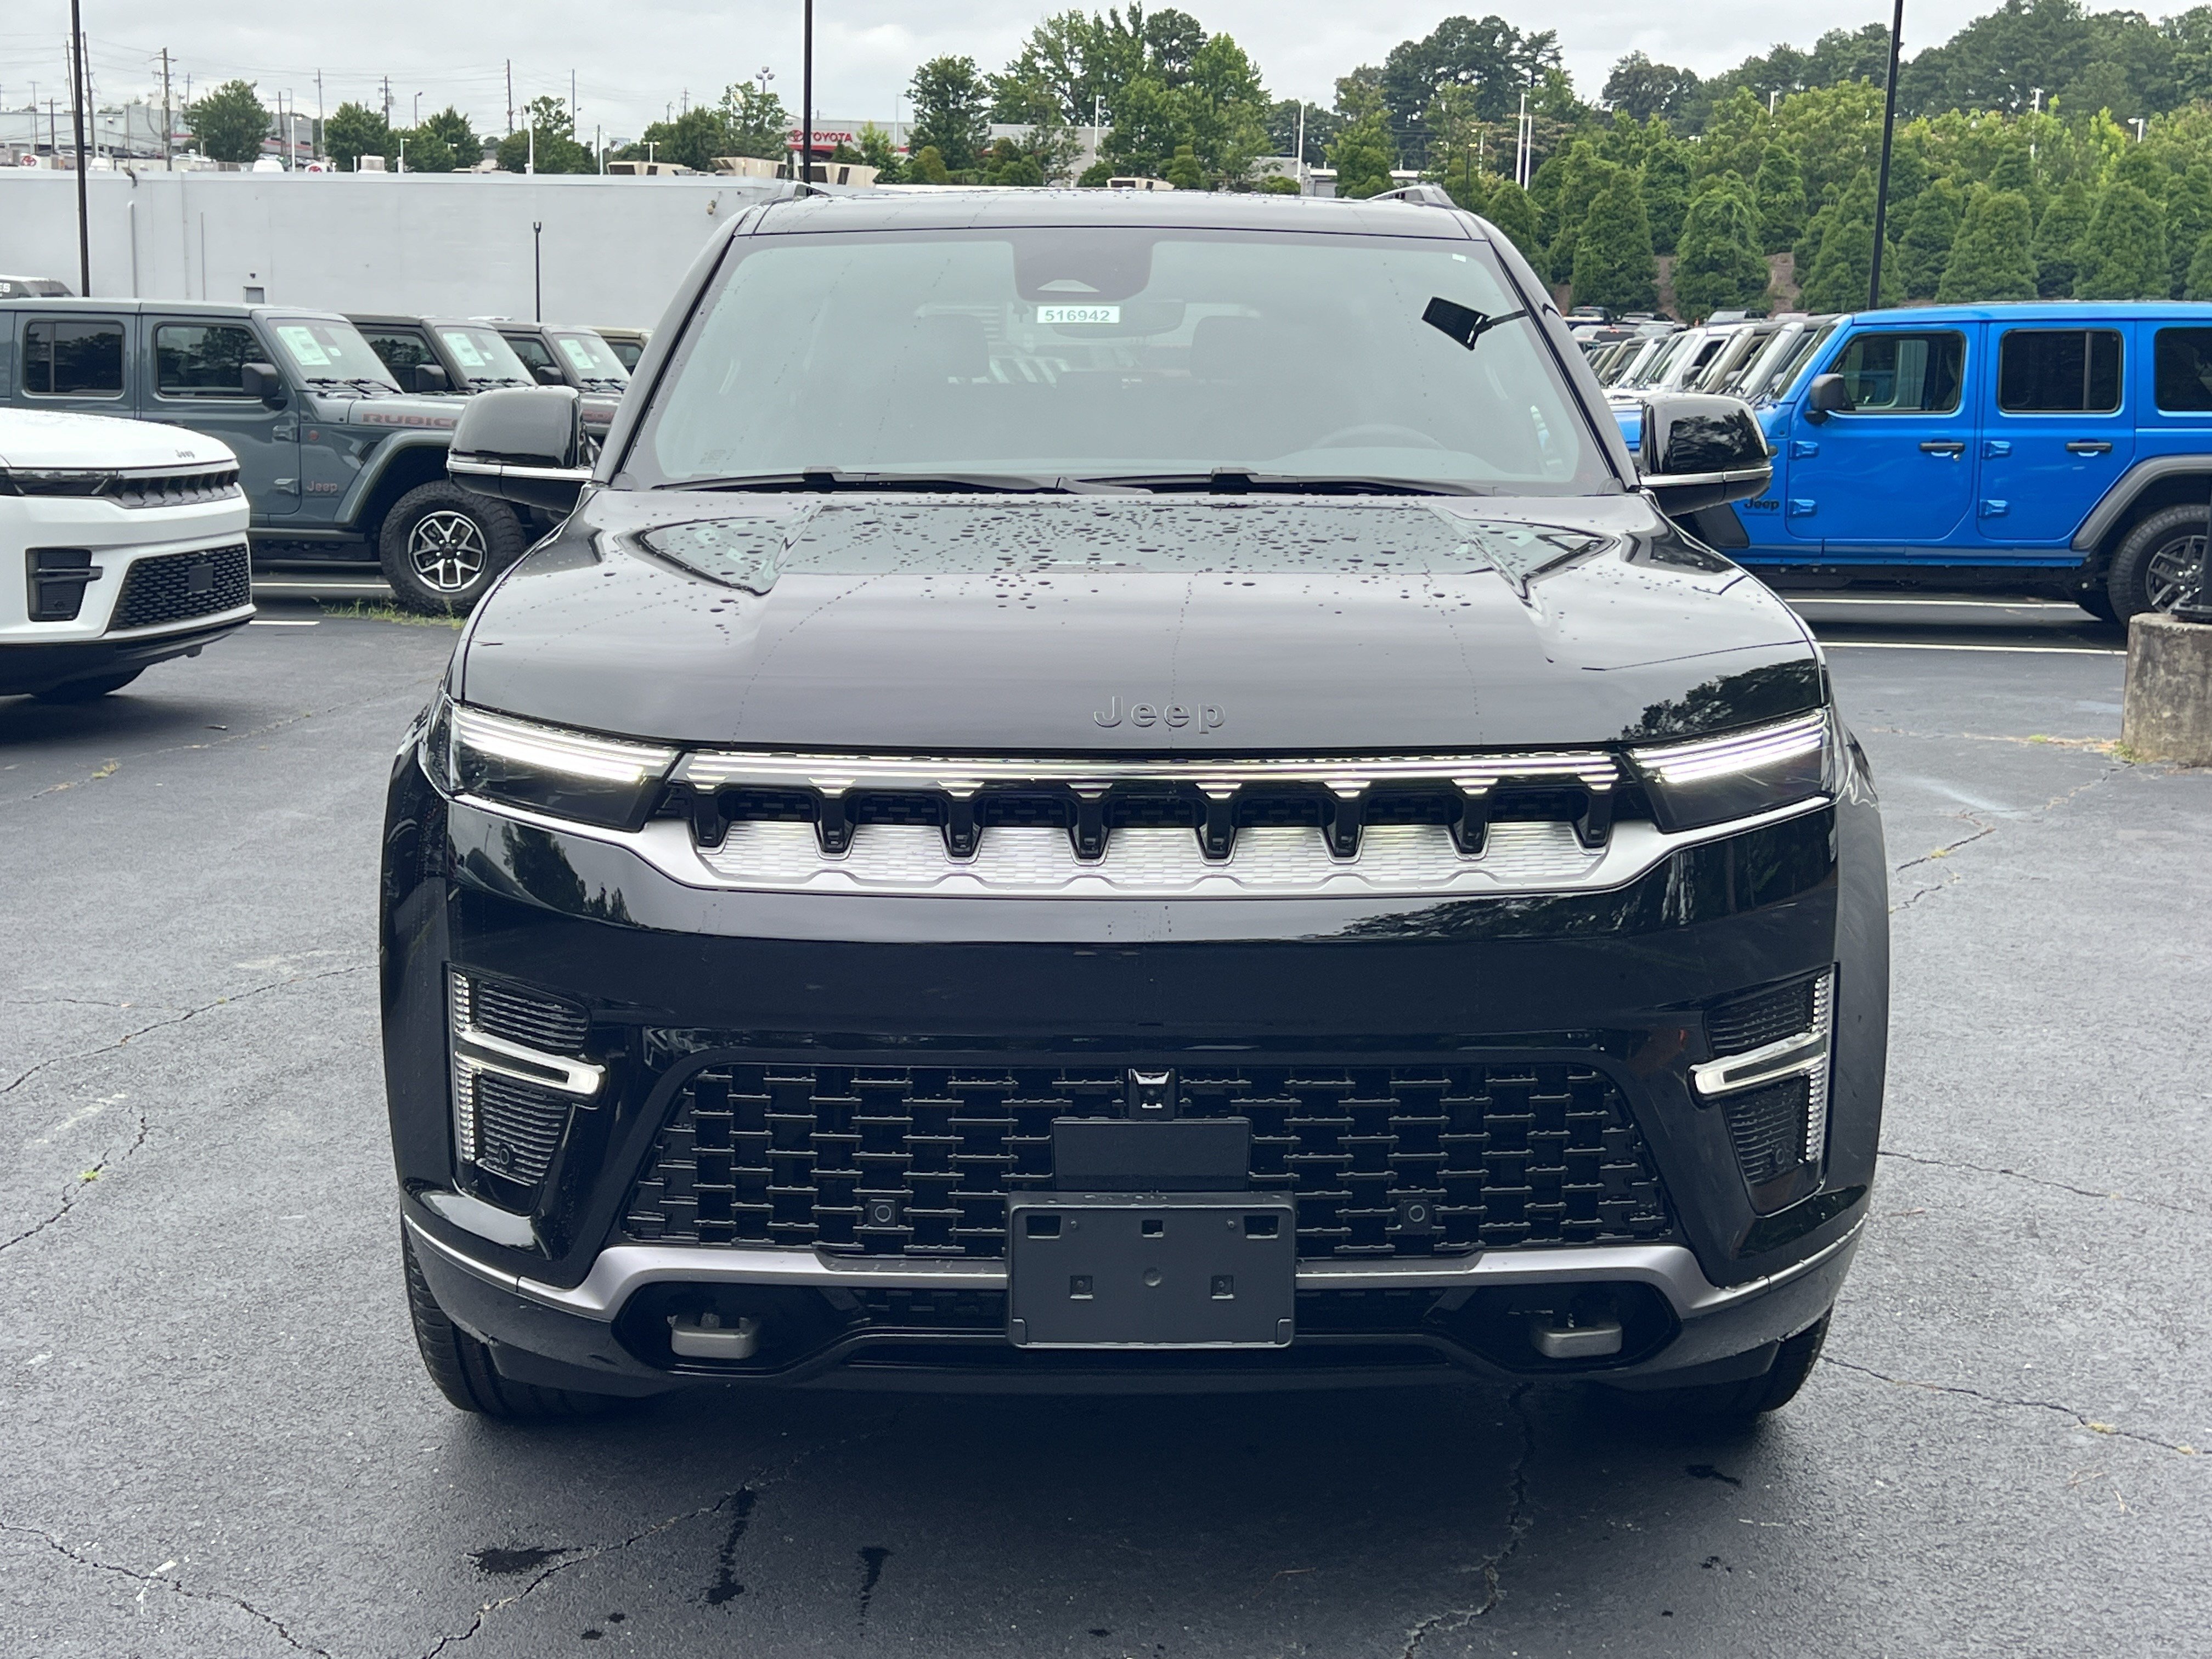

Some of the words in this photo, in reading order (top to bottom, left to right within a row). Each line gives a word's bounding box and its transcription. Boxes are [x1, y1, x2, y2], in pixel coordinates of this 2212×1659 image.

[810, 131, 853, 143] OYOTA
[1045, 310, 1110, 321] 516942
[307, 481, 338, 493] Jeep
[1744, 497, 1780, 511] Jeep
[1094, 696, 1226, 735] Jeep
